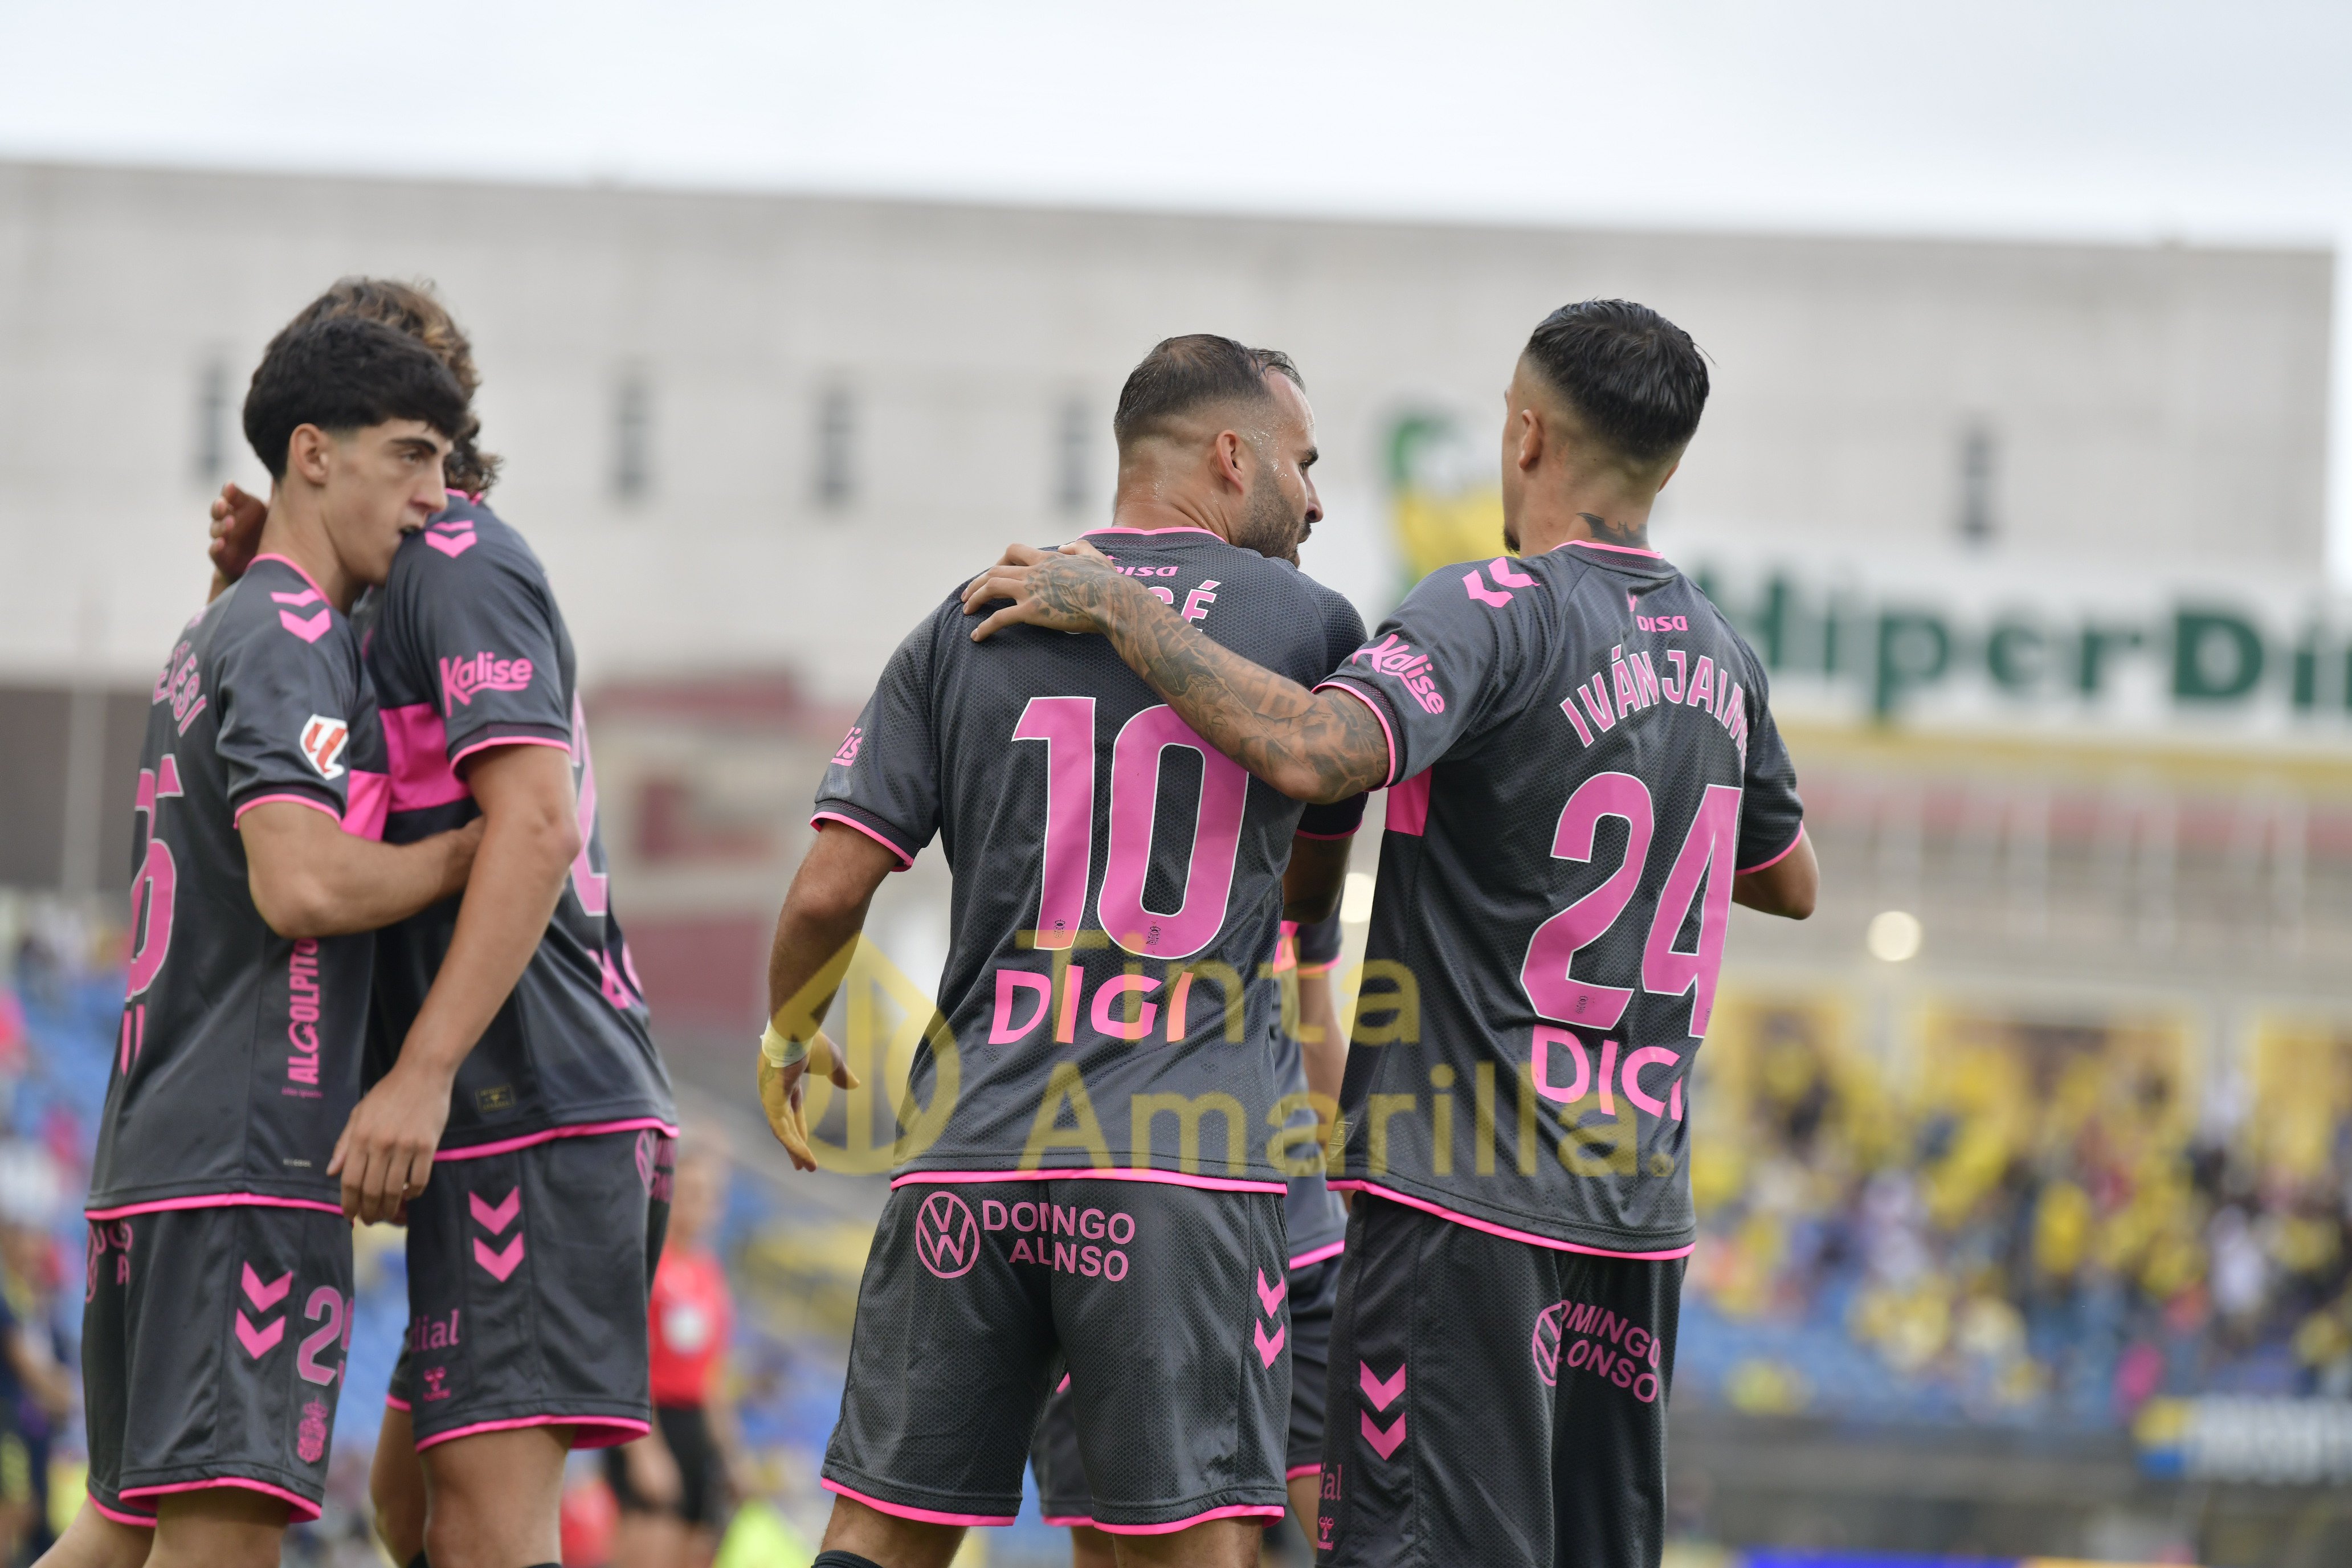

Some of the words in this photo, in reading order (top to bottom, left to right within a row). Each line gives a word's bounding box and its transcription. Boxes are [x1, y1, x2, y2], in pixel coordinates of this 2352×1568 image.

[439, 651, 533, 718] Kalise
[1352, 634, 1445, 714] Kalise
[1559, 644, 1660, 748] IVÁN
[1661, 650, 1748, 778] JAIM
[1694, 571, 2352, 726] HiperDi
[1011, 696, 1250, 959] 10
[1520, 771, 1742, 1039] 24
[987, 965, 1194, 1044] DIGI
